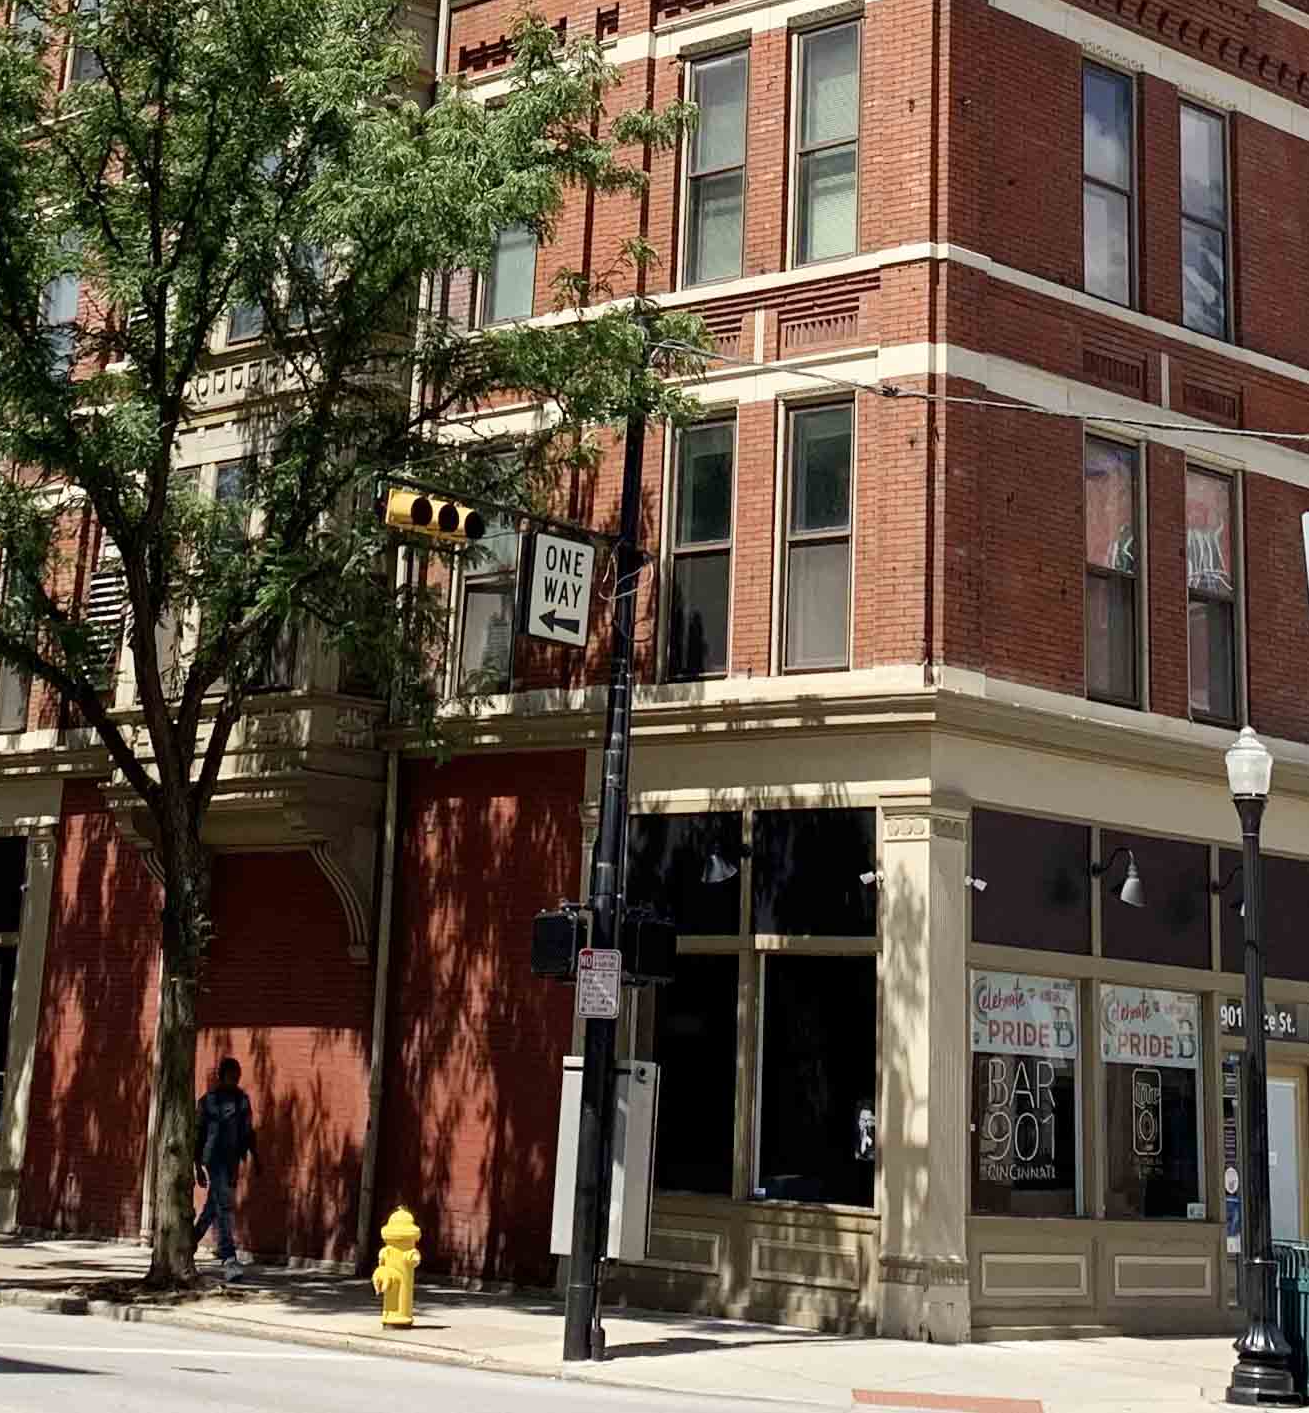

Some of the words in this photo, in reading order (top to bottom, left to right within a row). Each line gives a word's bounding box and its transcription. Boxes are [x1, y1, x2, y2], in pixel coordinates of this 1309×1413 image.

[546, 545, 584, 578] ONE
[544, 575, 582, 608] WAY
[580, 955, 593, 967] NO
[988, 1019, 1051, 1048] PRIDE
[1220, 1005, 1242, 1027] 901
[1279, 1012, 1296, 1033] St.
[1117, 1033, 1173, 1059] PRIDE
[988, 1058, 1056, 1109] BAR
[988, 1111, 1056, 1162] 901
[987, 1163, 1057, 1181] CINCINNATI
